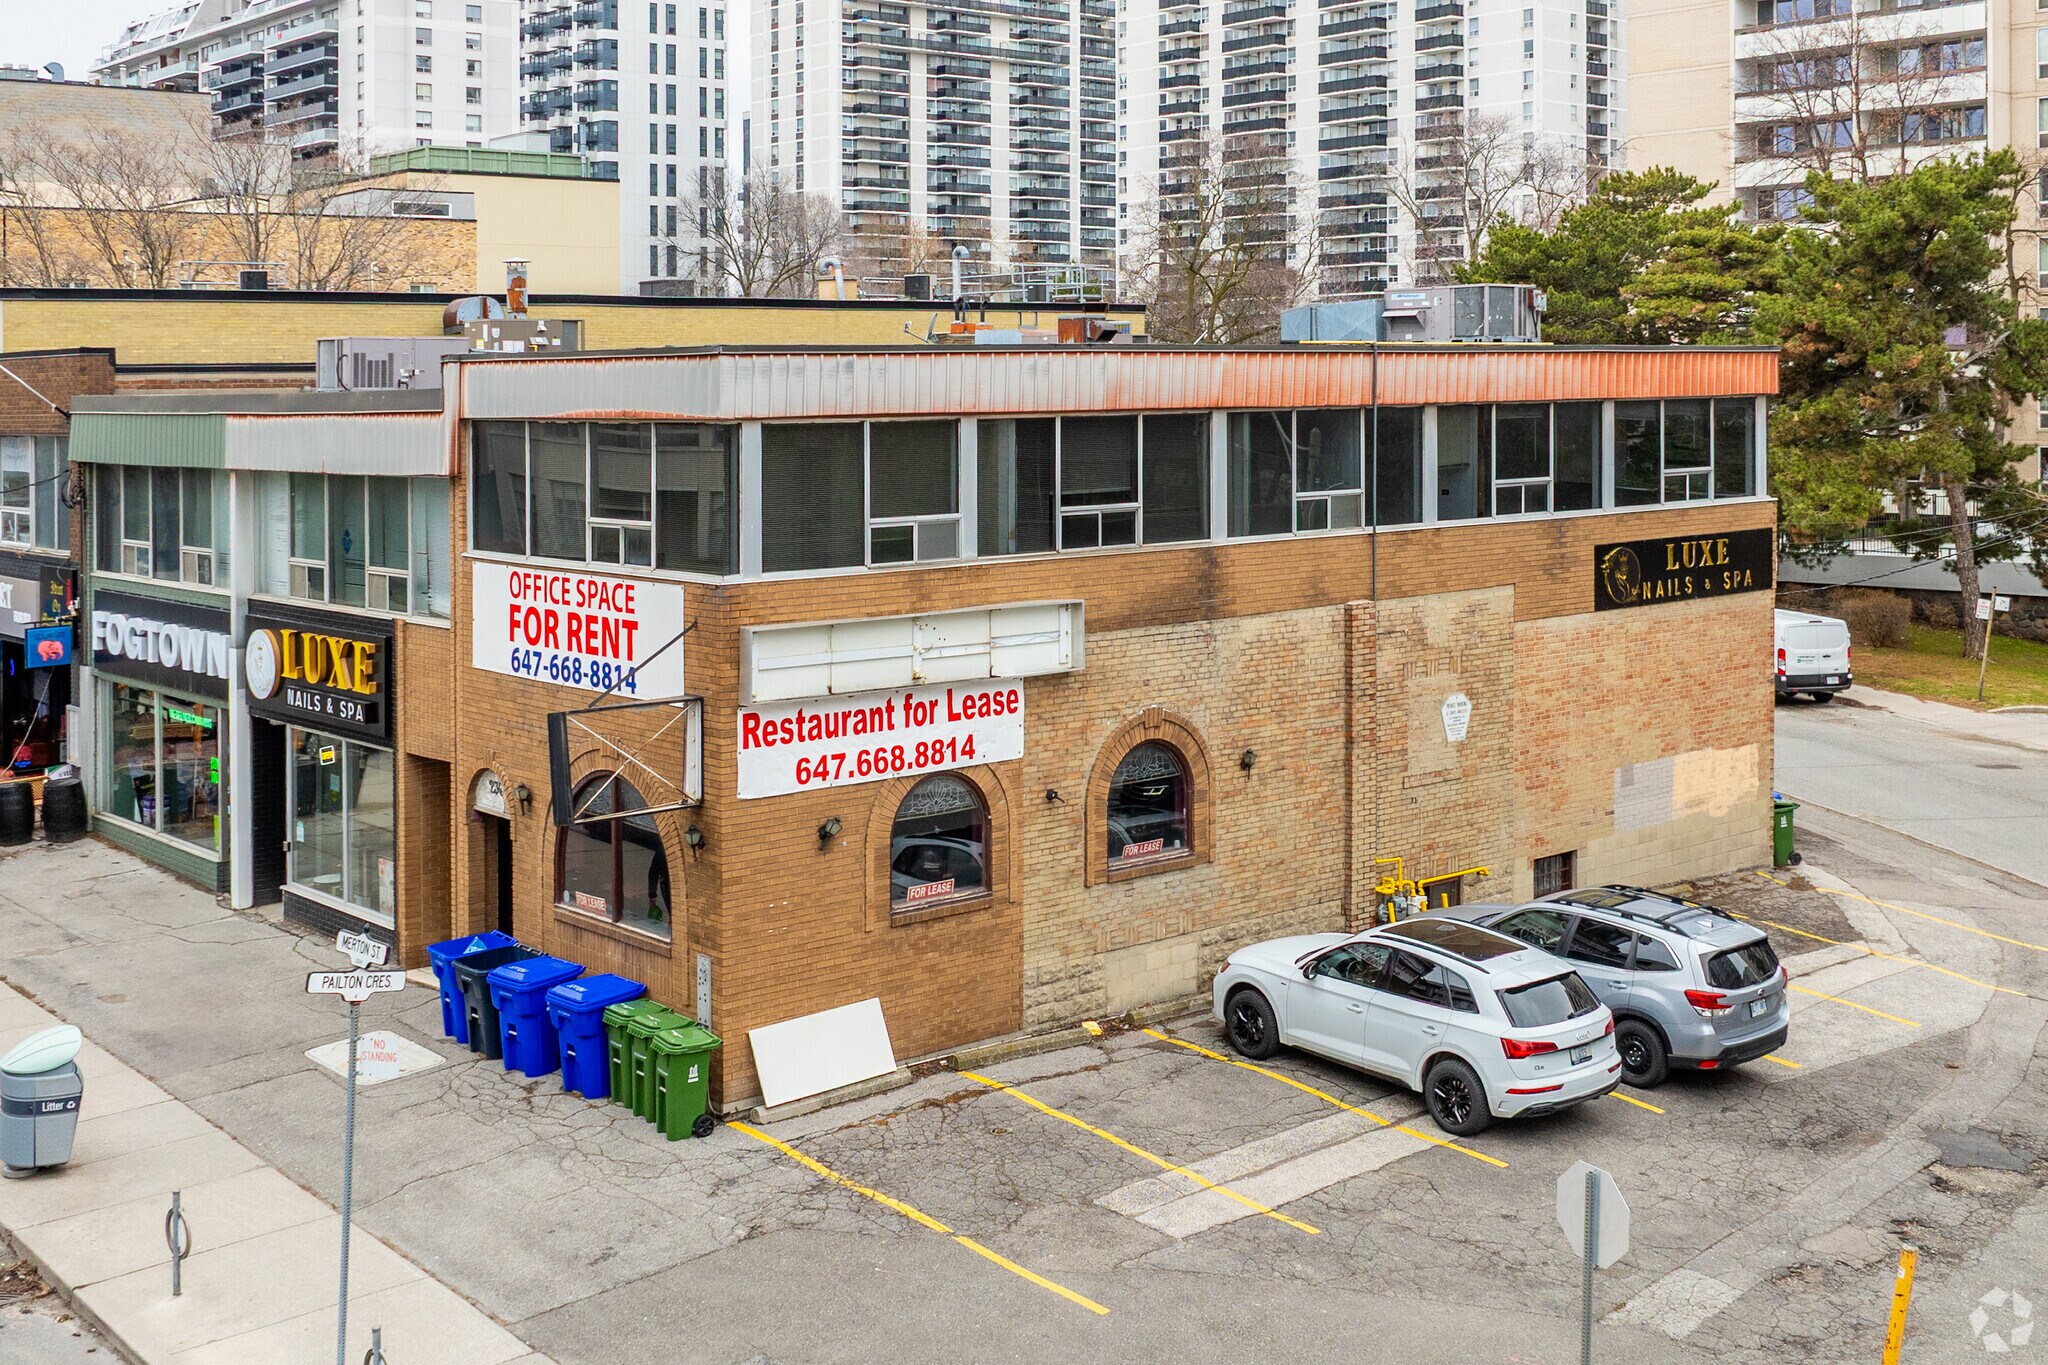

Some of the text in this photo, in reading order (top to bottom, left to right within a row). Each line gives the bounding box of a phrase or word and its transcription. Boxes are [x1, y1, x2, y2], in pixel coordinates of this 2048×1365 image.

[1665, 538, 1729, 571] LUXE
[509, 571, 635, 614] OFFICE SPACE
[1642, 569, 1752, 600] NAILS & SPA
[92, 610, 231, 679] FOGTOWN
[509, 603, 638, 662] FOR RENT
[280, 629, 377, 694] LUXE
[511, 647, 637, 694] 647-668-8814
[287, 688, 364, 722] NAILS & SPA
[742, 688, 1019, 749] Restaurant for Lease
[796, 734, 975, 785] 647.668.8814
[1125, 842, 1160, 856] FOR LEASE
[910, 881, 952, 899] FOR LEASE
[342, 936, 370, 955] MERTON
[322, 976, 363, 988] PAILTON
[361, 1050, 398, 1062] STANDING
[373, 1039, 386, 1049] NO
[42, 1100, 65, 1112] Litter
